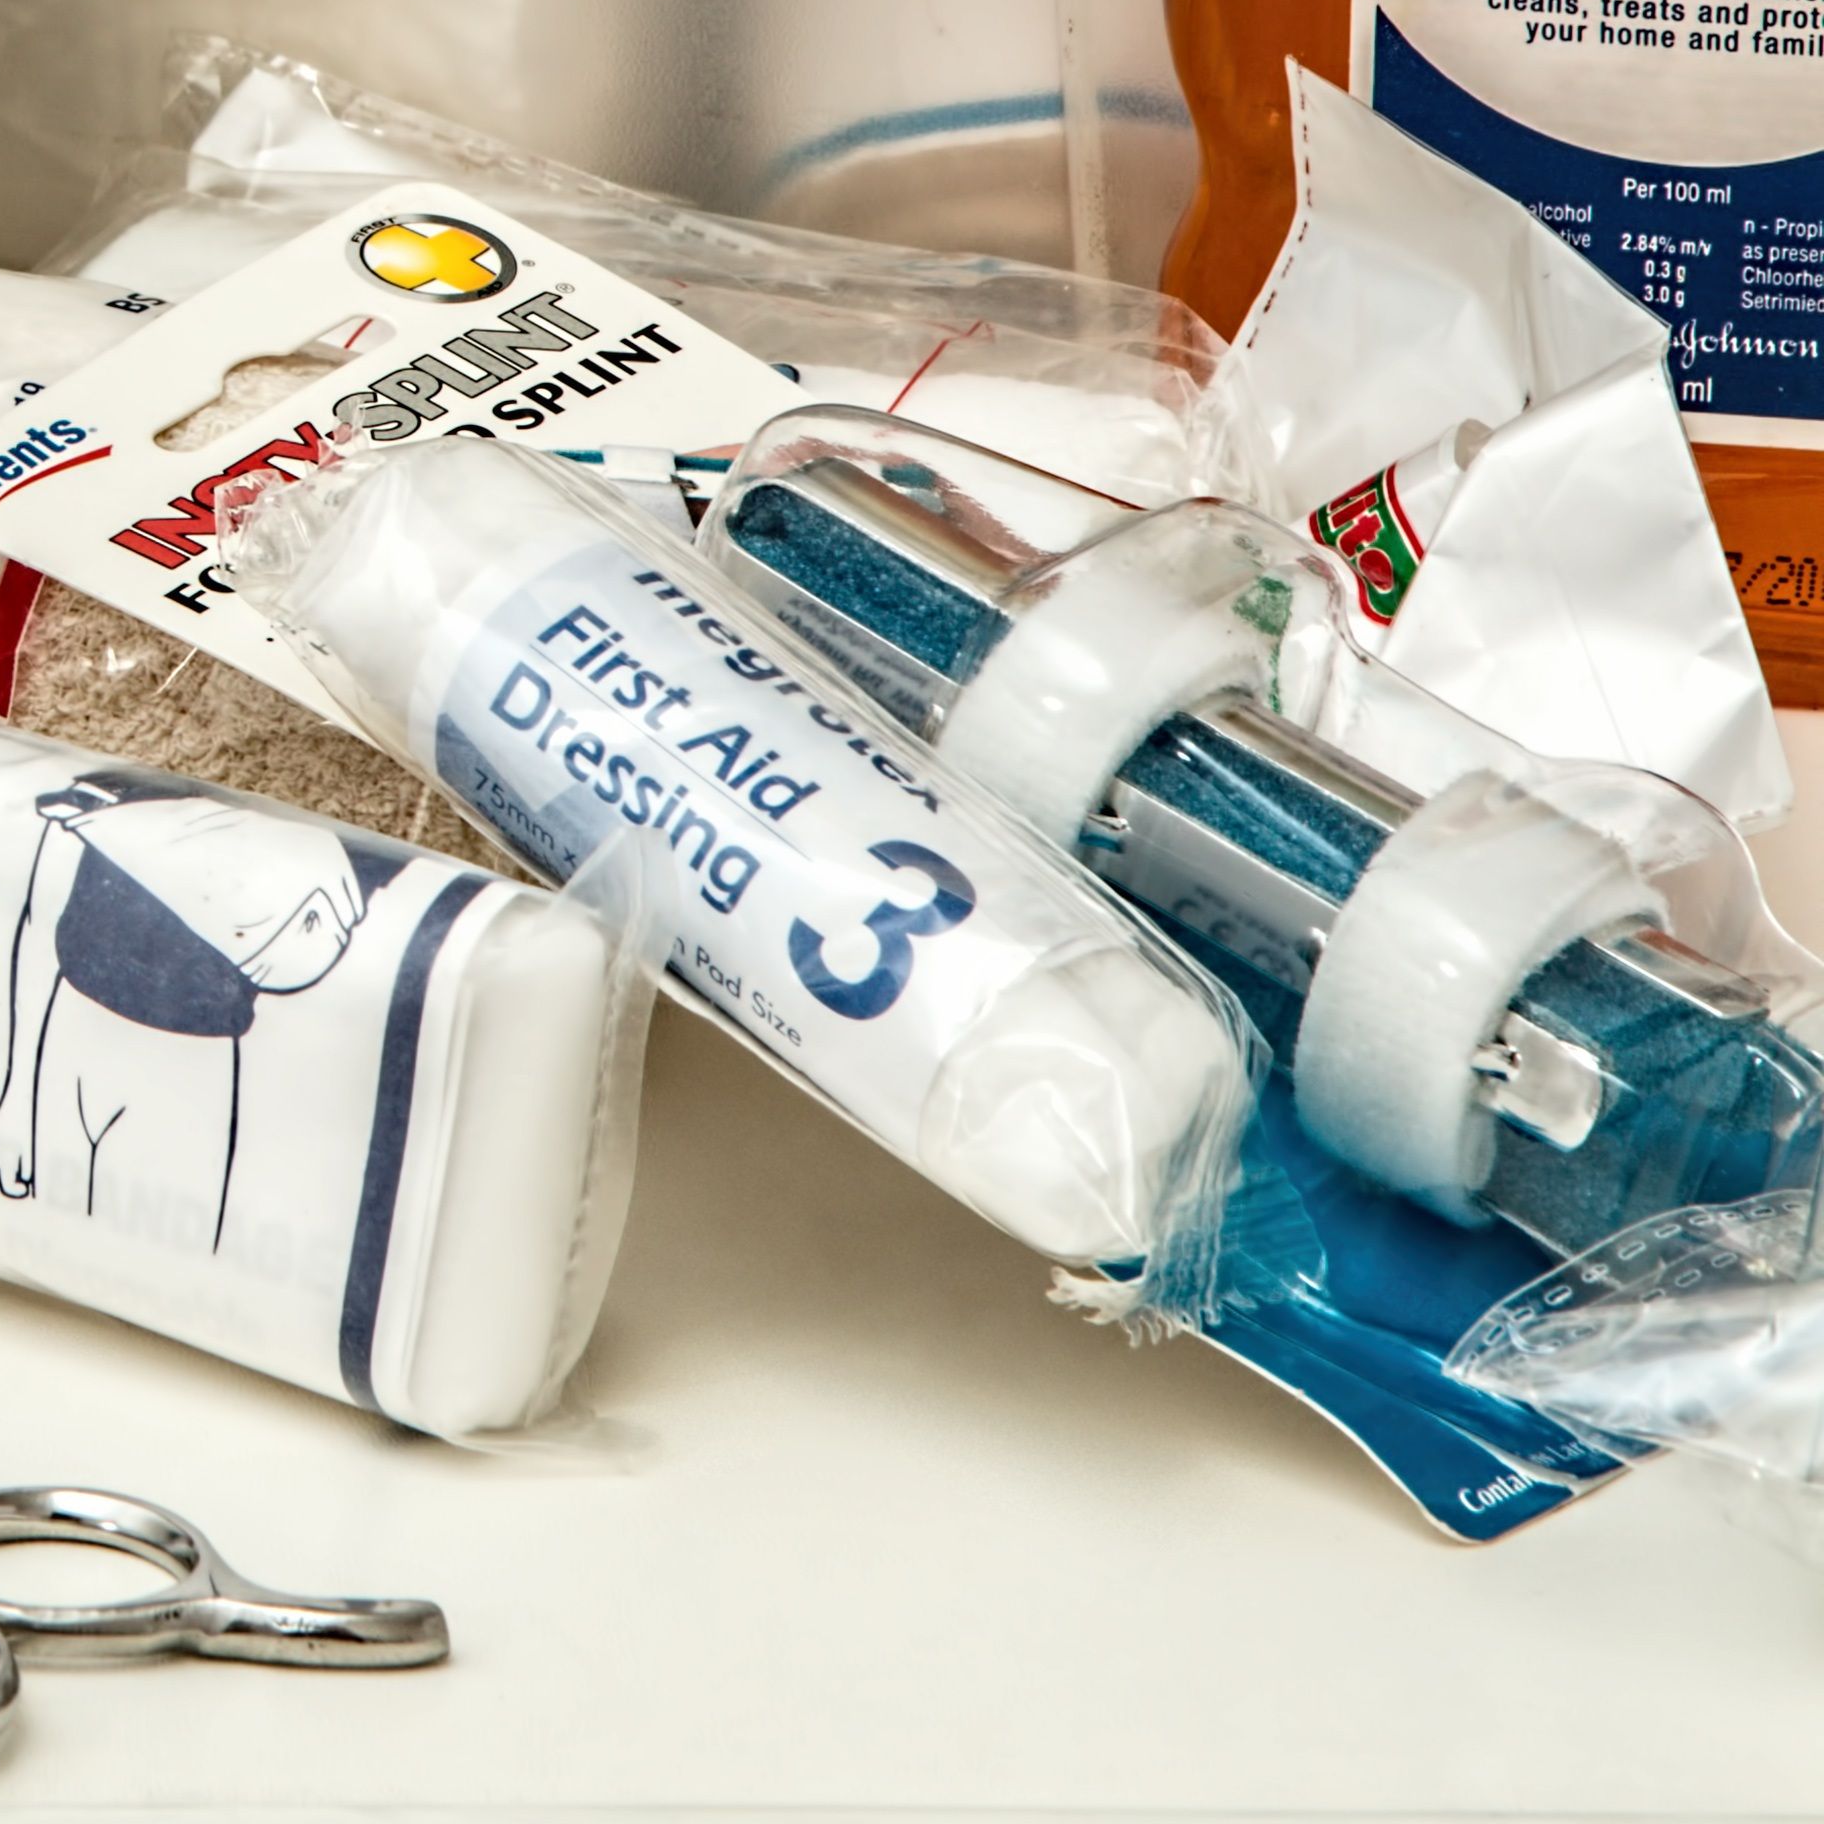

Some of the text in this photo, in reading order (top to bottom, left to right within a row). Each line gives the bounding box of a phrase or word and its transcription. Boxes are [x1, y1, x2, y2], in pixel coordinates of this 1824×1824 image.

[1696, 0, 1750, 27] and
[1525, 19, 1587, 45] your
[1598, 22, 1676, 51] home
[1688, 26, 1740, 54] and
[1622, 177, 1732, 205] Per 100 ml
[350, 216, 399, 245] FIRST
[1620, 232, 1713, 258] 2.84% m/v
[1742, 245, 1764, 260] as
[1644, 260, 1687, 284] 0.3 g
[476, 278, 506, 300] AID
[1643, 284, 1686, 309] 3.0 g
[491, 323, 683, 431] SPLINT
[1682, 377, 1713, 403] ml
[538, 601, 692, 733] First
[680, 705, 824, 824] Aid
[487, 659, 763, 913] Dressing
[471, 766, 557, 849] 75mm
[786, 838, 979, 1022] 3
[693, 937, 805, 1050] Pad Size
